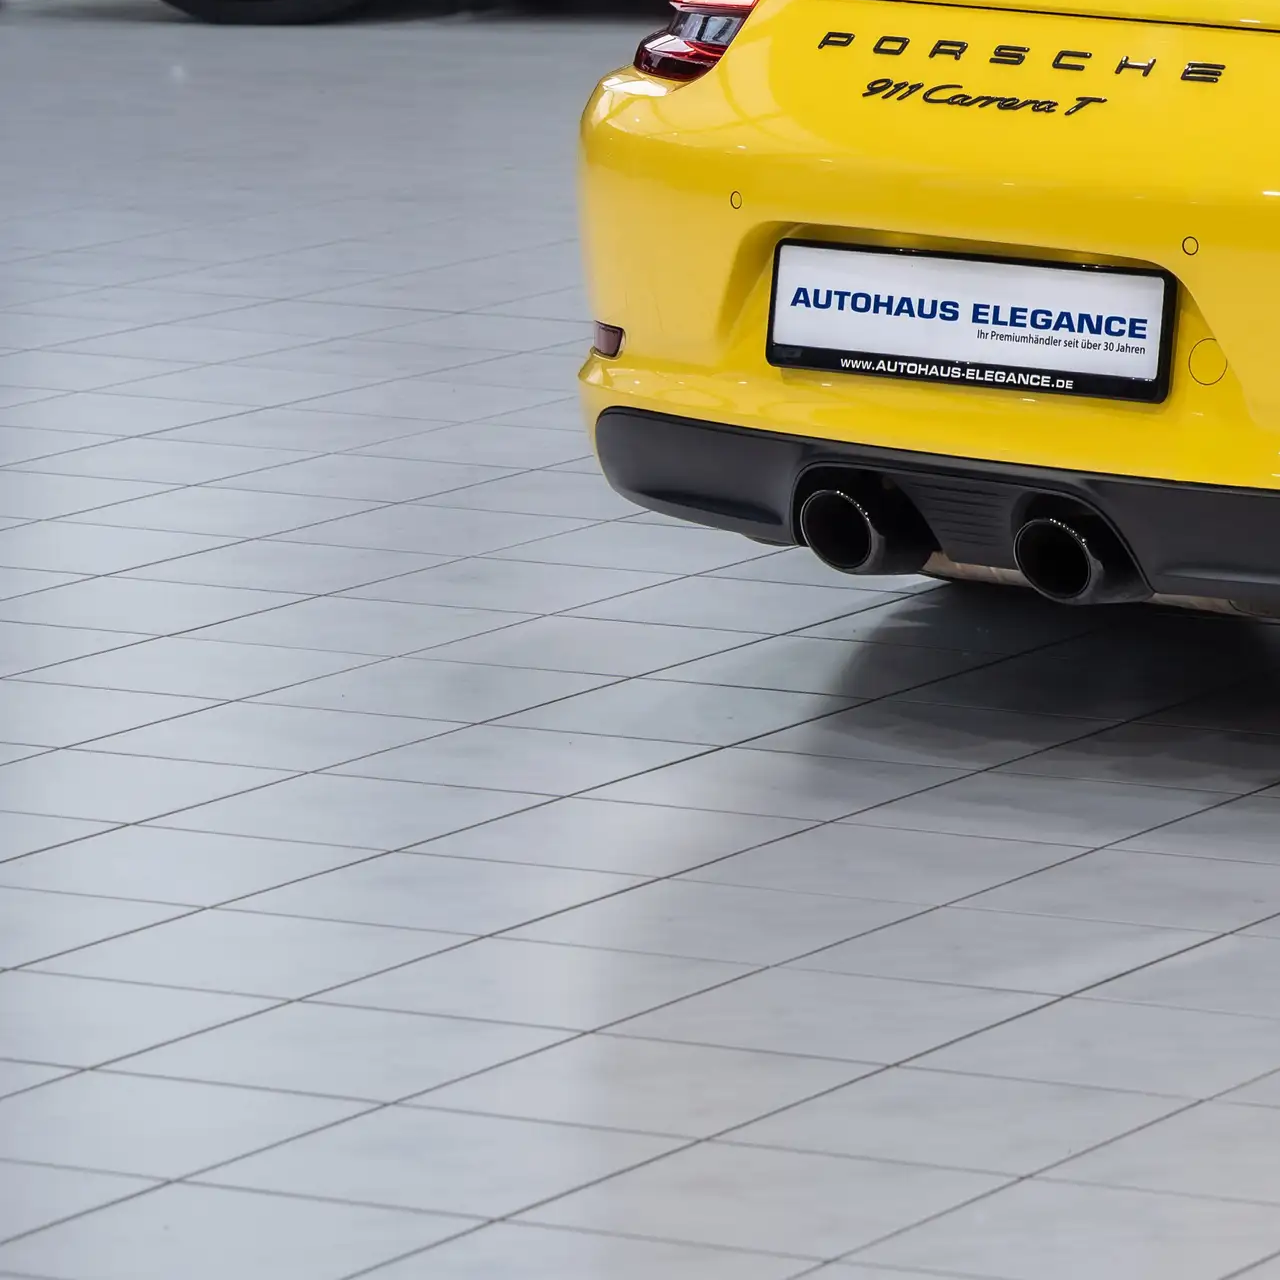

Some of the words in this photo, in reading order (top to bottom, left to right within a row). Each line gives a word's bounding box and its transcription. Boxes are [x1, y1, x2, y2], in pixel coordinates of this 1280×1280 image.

[818, 31, 1226, 83] PORSCHE
[862, 78, 923, 100] 911
[922, 84, 1059, 114] Carrera
[1064, 97, 1107, 116] T
[790, 287, 960, 322] AUTOHAUS
[971, 303, 1148, 339] ELEGANCE
[976, 329, 989, 340] Ihr
[990, 330, 1061, 347] Premiumhändler
[1063, 338, 1079, 349] seit
[1081, 339, 1101, 351] über
[1103, 341, 1114, 352] 30
[1115, 343, 1146, 355] Jahren
